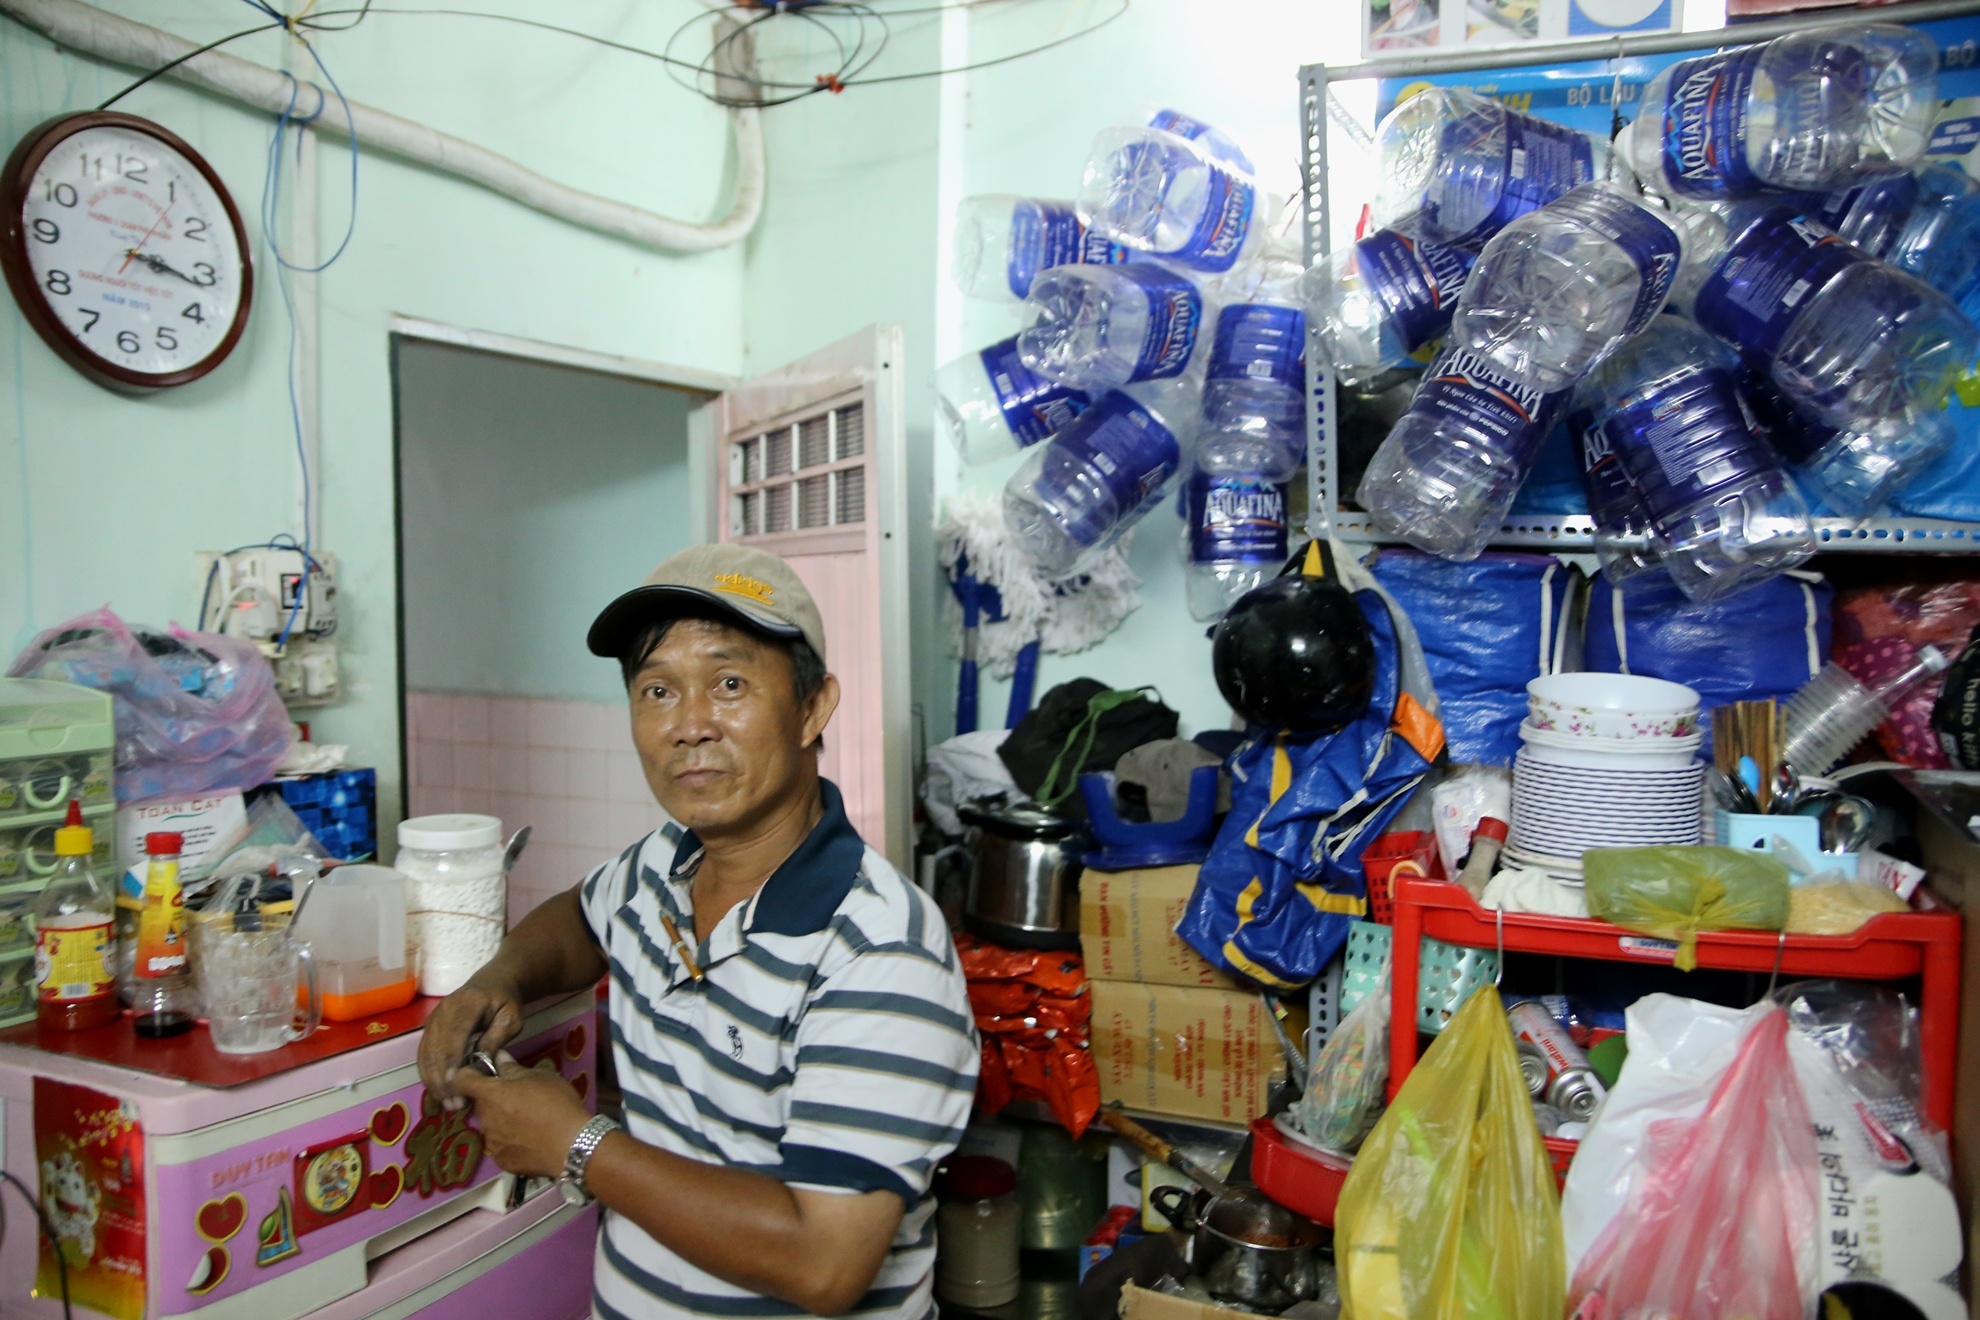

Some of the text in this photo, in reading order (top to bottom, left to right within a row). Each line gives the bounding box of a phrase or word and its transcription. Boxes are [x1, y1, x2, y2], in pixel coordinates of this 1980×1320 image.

[1567, 82, 1592, 108] BỘ
[1681, 61, 1727, 180] AQUAFINA
[80, 153, 101, 181] 11
[116, 153, 148, 184] 12
[44, 178, 78, 208] 10
[168, 181, 175, 202] 1
[32, 218, 60, 244] 9
[184, 217, 207, 242] 2
[47, 269, 72, 296] 8
[191, 262, 216, 287] 3
[78, 307, 100, 333] 7
[182, 302, 206, 325] 4
[116, 331, 141, 354] 6
[155, 326, 178, 351] 5
